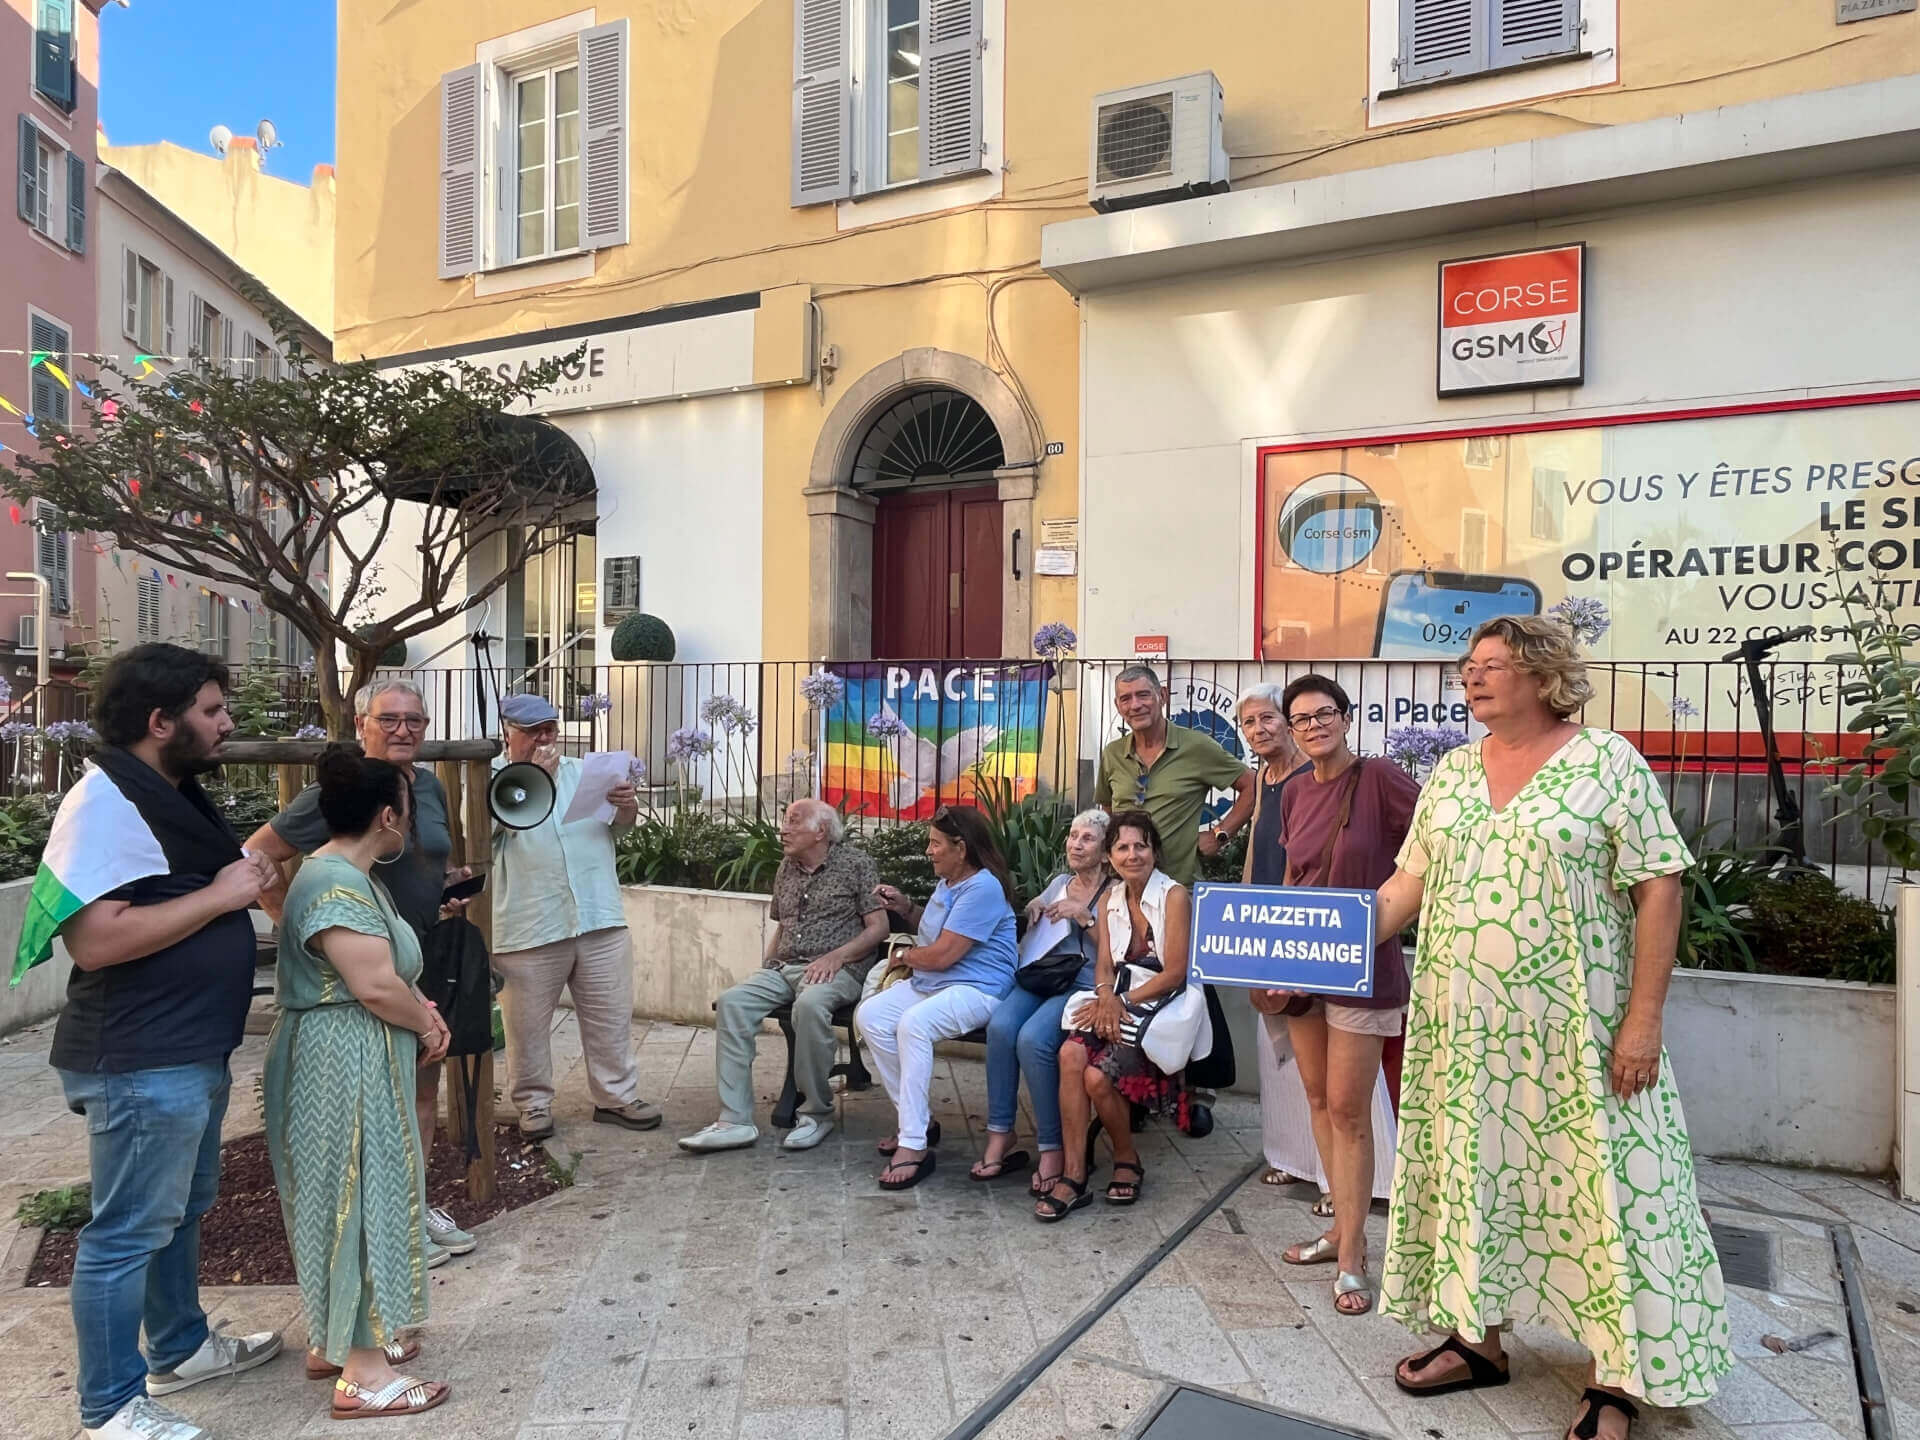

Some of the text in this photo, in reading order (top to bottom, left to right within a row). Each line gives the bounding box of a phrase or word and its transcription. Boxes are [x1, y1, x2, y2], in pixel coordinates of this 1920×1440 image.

[1453, 279, 1569, 315] CORSE
[1452, 332, 1524, 361] GSM
[555, 384, 592, 396] PARIS
[1047, 443, 1063, 455] 60
[1563, 474, 1665, 506] VOUS
[1678, 472, 1699, 499] Y
[1709, 462, 1792, 497] ÊTES
[1820, 496, 1920, 532] LE S
[1304, 527, 1371, 540] Corse Gsm
[1561, 538, 1920, 582] OPÉRATEUR CO
[1719, 582, 1828, 612] VOUS
[1136, 643, 1166, 651] CORSE
[1665, 628, 1699, 645] AU
[1708, 627, 1737, 644] 22
[887, 667, 995, 701] PACE
[1186, 684, 1233, 714] POUR
[1368, 703, 1383, 723] a
[1394, 697, 1468, 723] Pace
[1222, 903, 1342, 929] A PIAZZETTA
[1200, 935, 1362, 964] JULIAN ASSANGE
